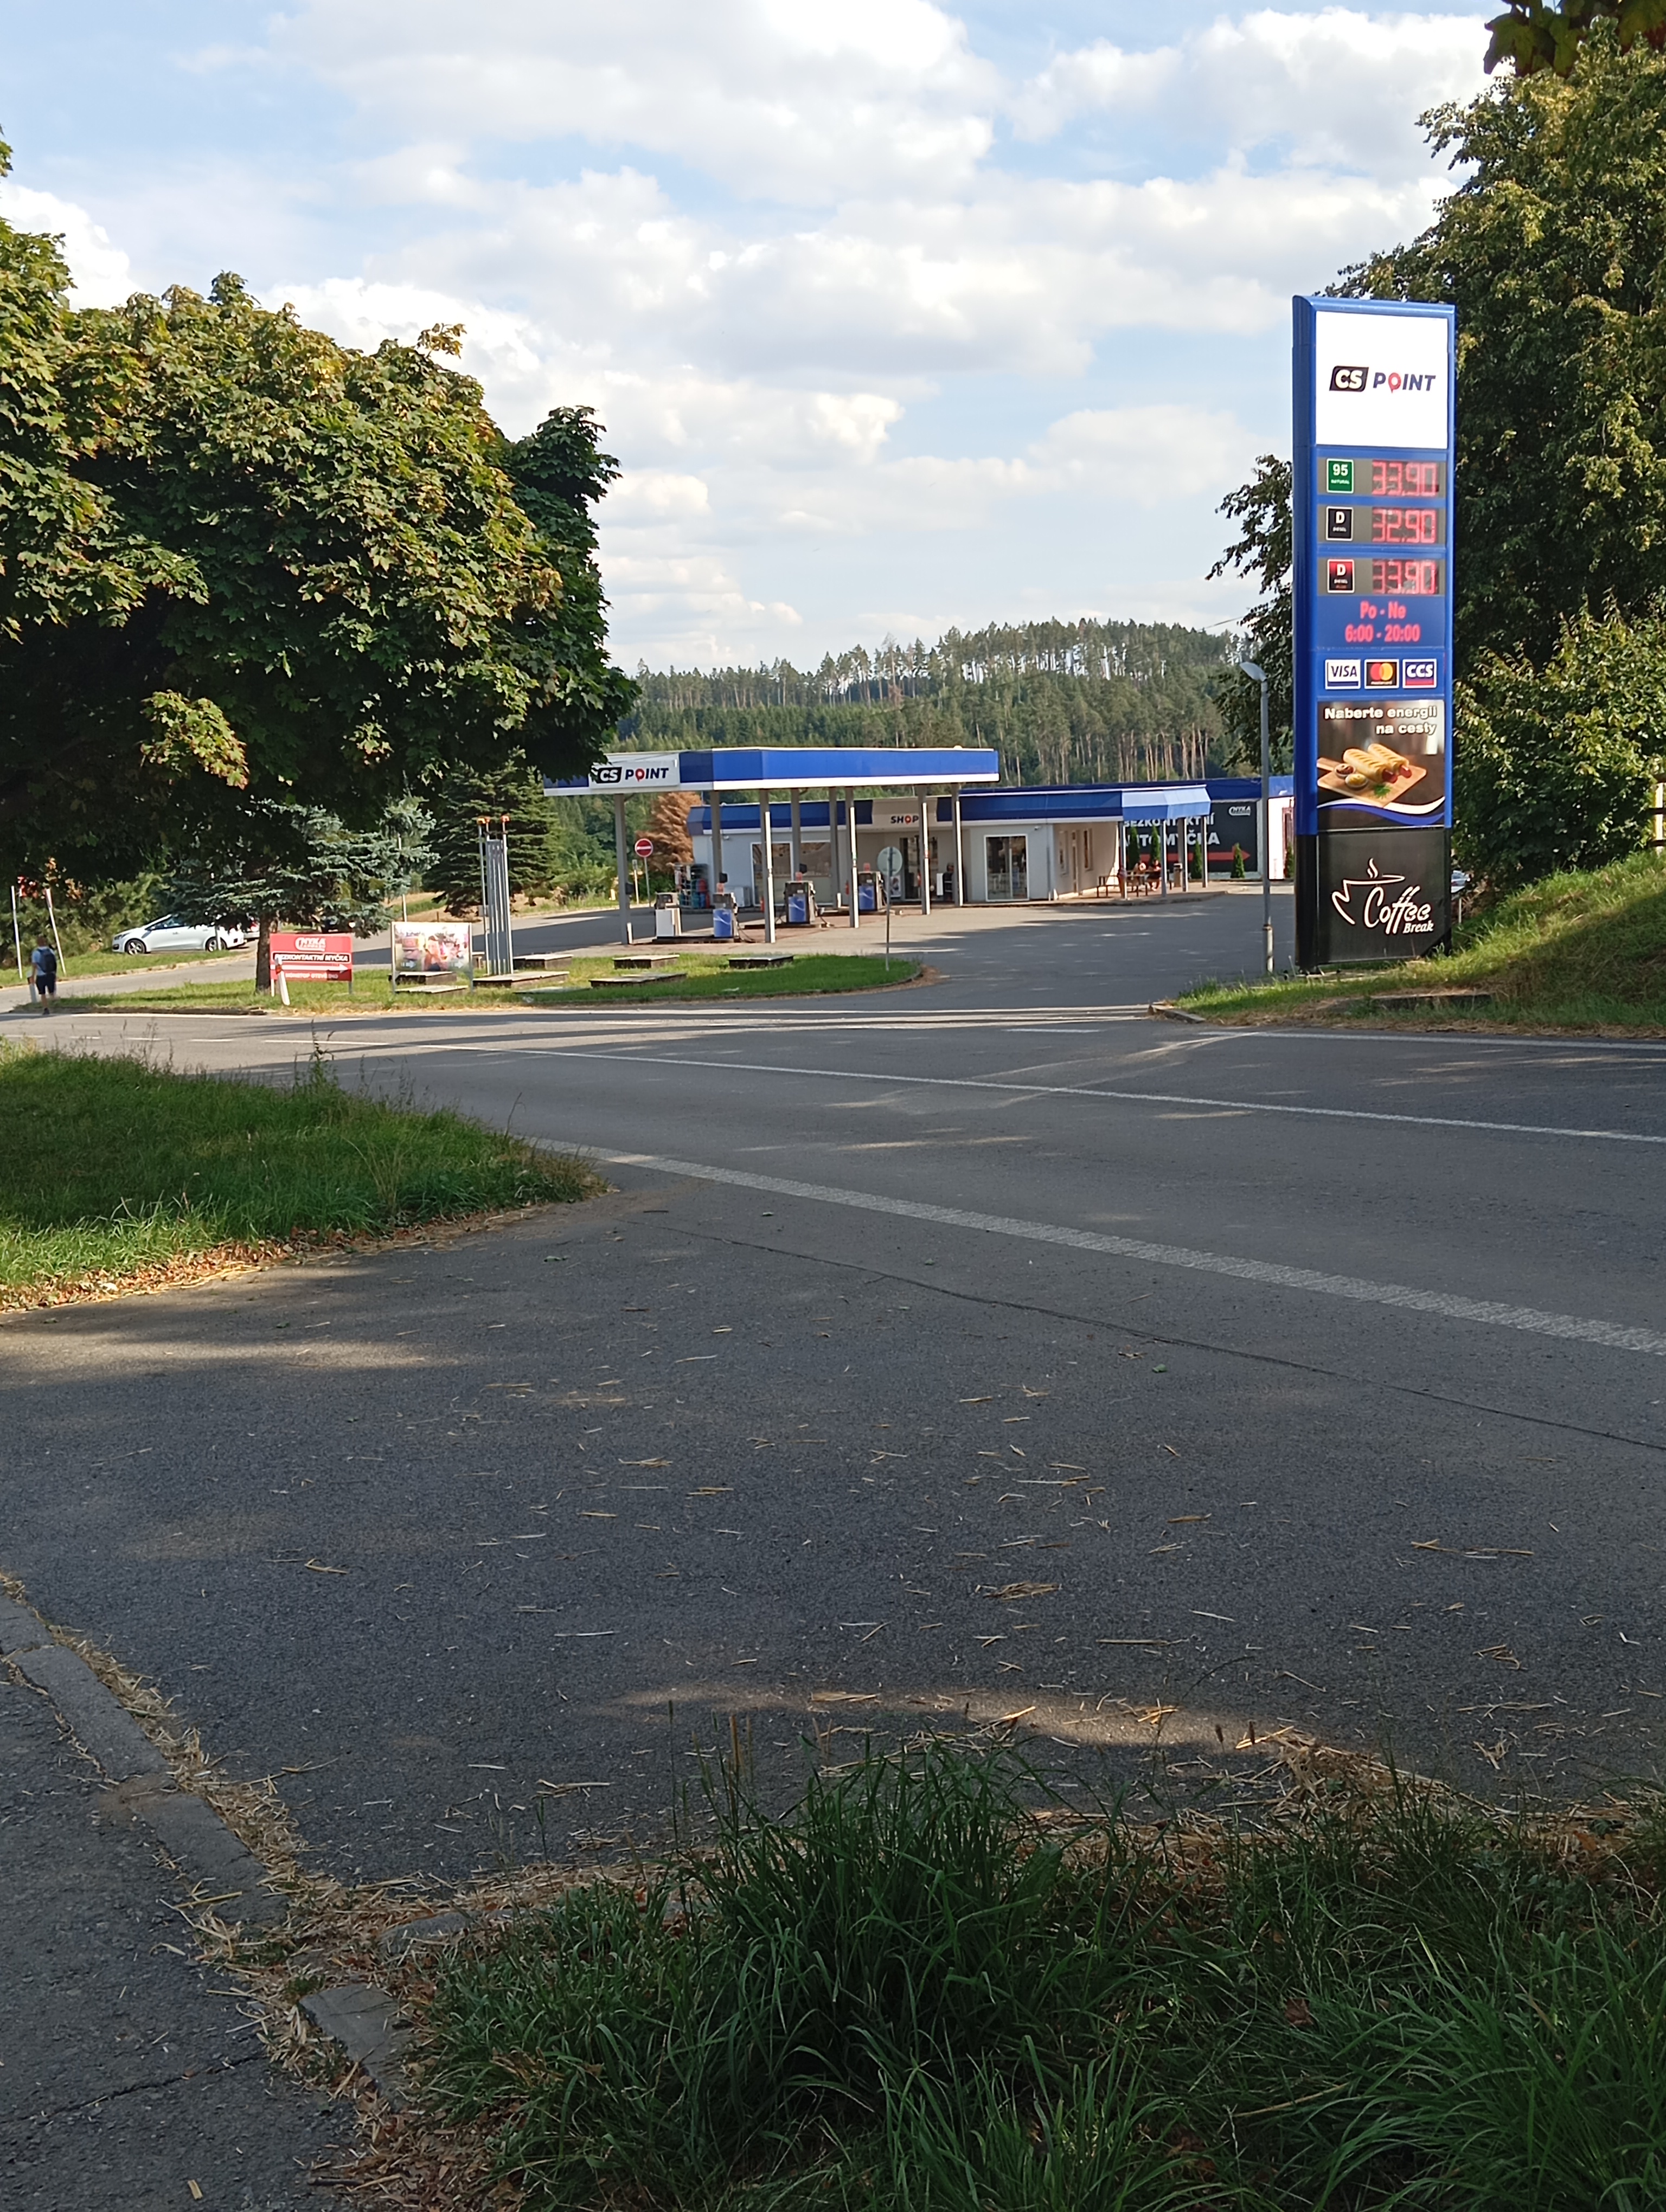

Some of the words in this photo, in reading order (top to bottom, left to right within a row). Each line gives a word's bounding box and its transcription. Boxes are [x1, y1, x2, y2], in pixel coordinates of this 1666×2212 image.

[1334, 369, 1364, 390] CS
[1373, 372, 1436, 393] POINT
[1333, 464, 1348, 476] 95
[1336, 511, 1345, 524] D
[1337, 564, 1346, 576] D
[1360, 601, 1377, 619] Po
[1388, 601, 1407, 619] Ne
[1345, 624, 1374, 642] 6:00
[1385, 624, 1421, 642] 20:00
[1331, 665, 1357, 677] VISA
[1407, 665, 1433, 678] CCS
[1324, 707, 1383, 719] Naberte
[1387, 706, 1437, 719] energii
[1376, 725, 1394, 734] na
[1398, 722, 1437, 735] cesty
[599, 769, 619, 782] CS
[625, 768, 669, 782] POINT
[890, 815, 919, 825] SHOP
[1124, 813, 1215, 827] BEZKONTKTÍ
[1364, 886, 1431, 934] Coffee
[1403, 920, 1434, 934] Break
